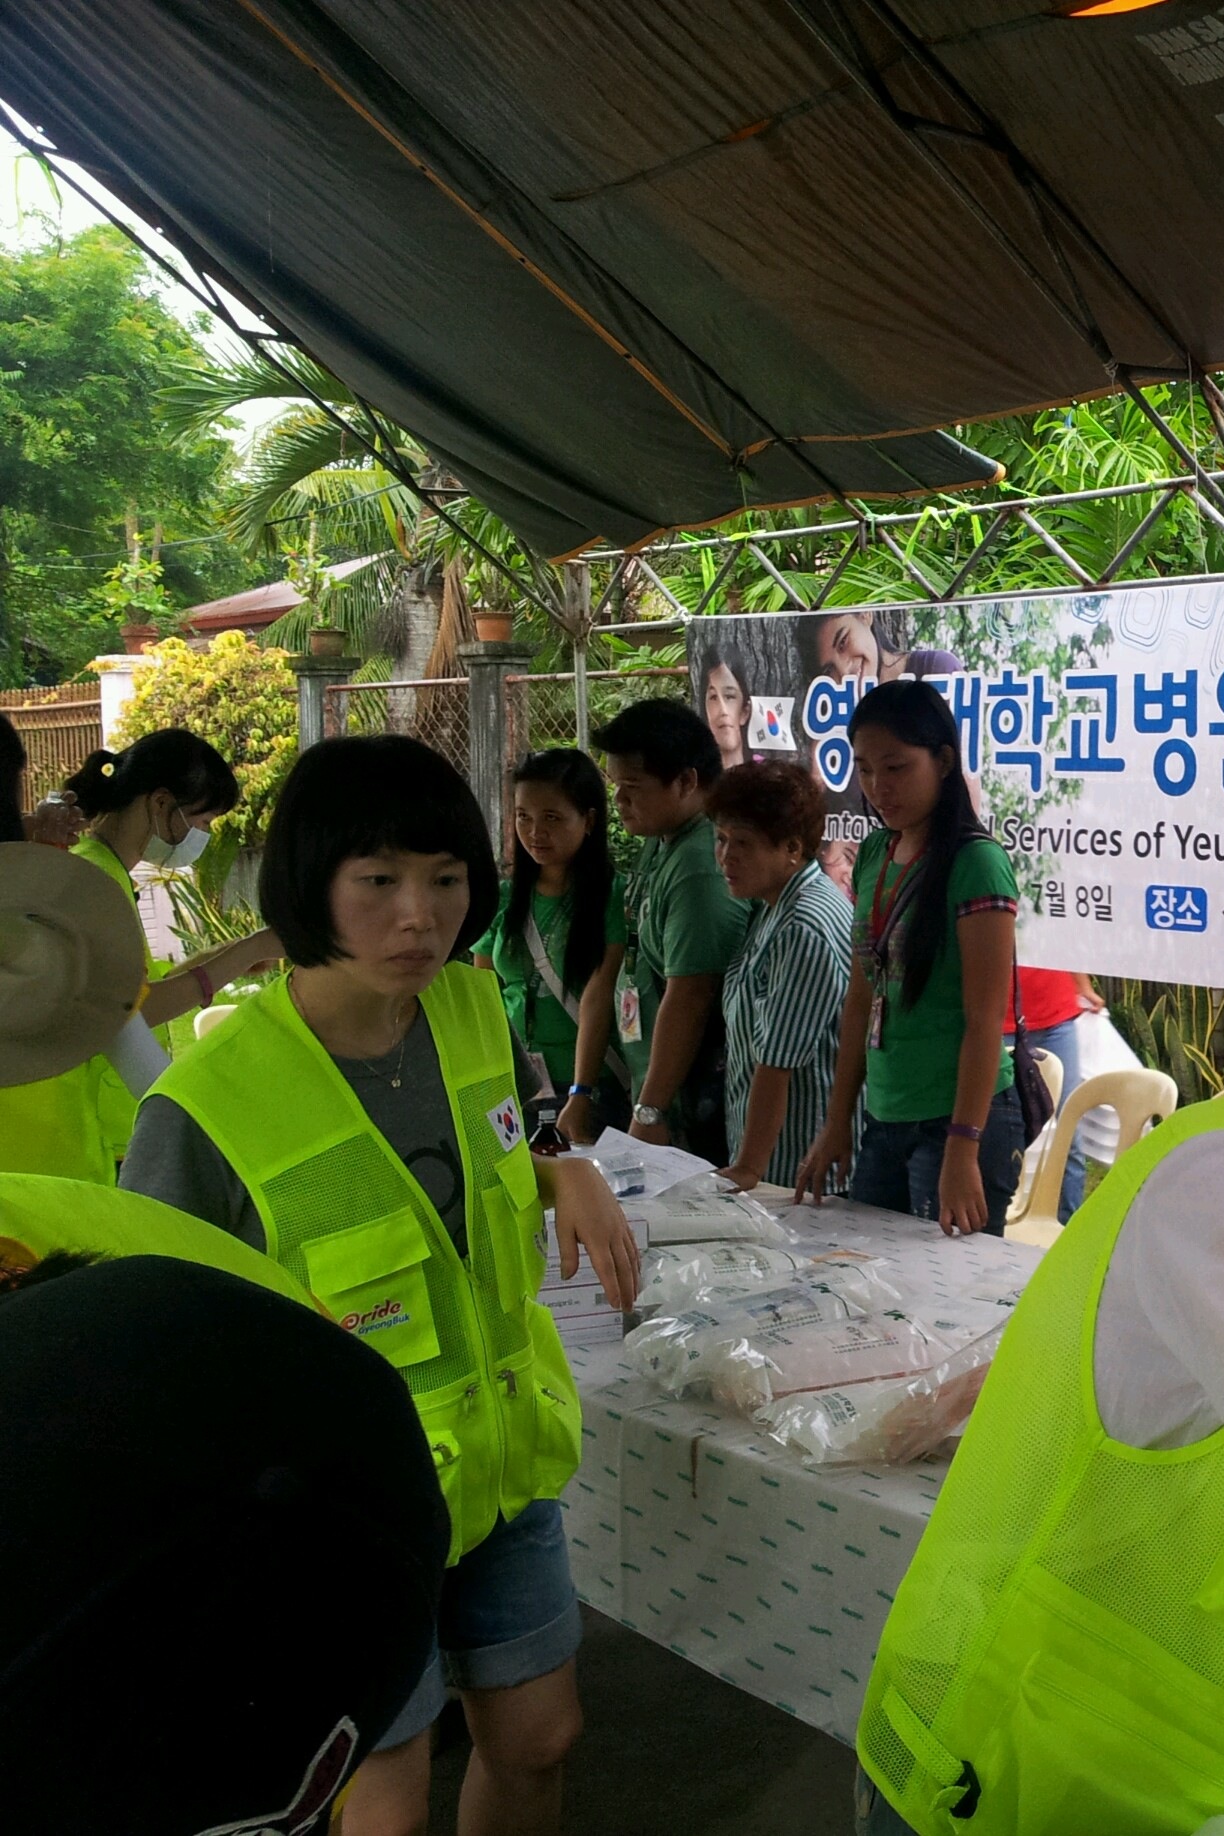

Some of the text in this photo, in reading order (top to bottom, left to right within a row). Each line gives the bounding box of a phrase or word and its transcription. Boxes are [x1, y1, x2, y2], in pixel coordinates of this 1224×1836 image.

[1002, 817, 1123, 857] Services
[1132, 821, 1166, 858] of
[1075, 884, 1114, 922] 8일
[1149, 888, 1203, 928] 장소
